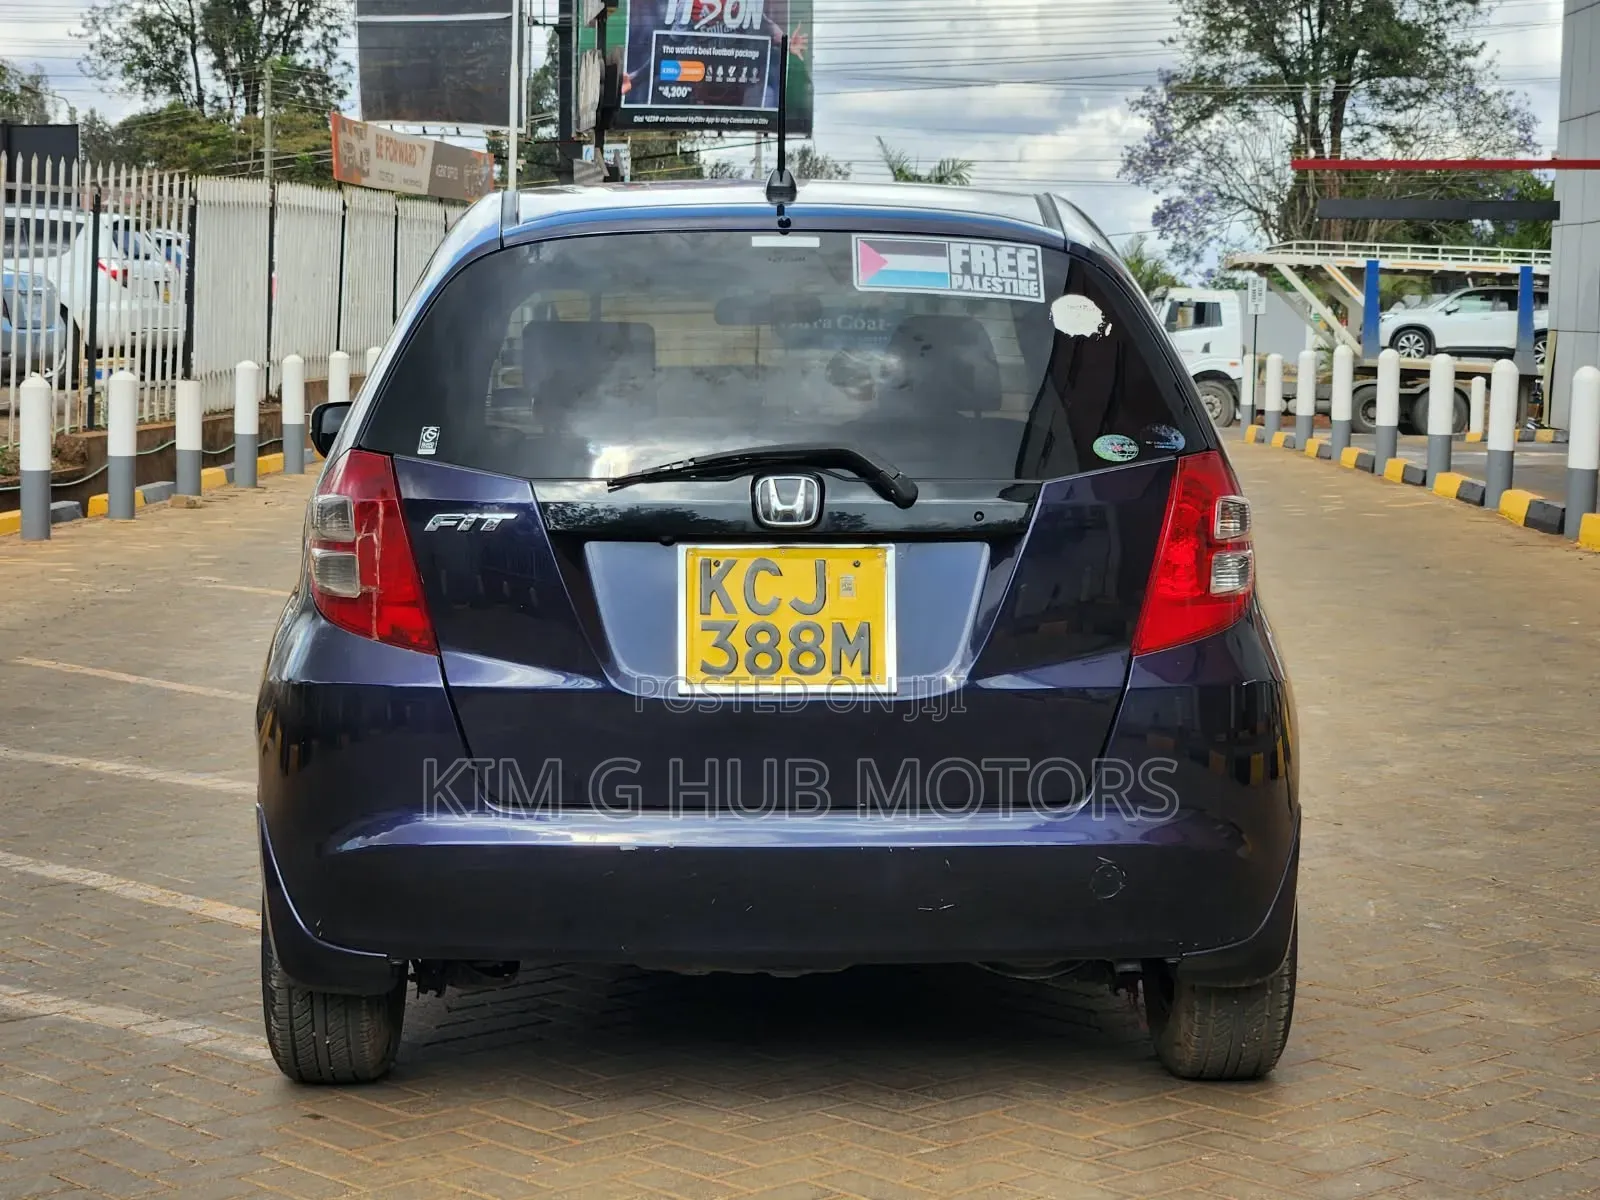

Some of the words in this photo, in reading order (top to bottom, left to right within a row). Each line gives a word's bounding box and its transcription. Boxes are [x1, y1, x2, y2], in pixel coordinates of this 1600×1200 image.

[662, 45, 674, 54] The
[675, 46, 697, 55] world's
[698, 46, 712, 55] best
[712, 47, 734, 57] football
[734, 48, 759, 60] package
[376, 133, 384, 159] BE
[385, 136, 417, 168] FORWARD
[949, 242, 1037, 280] FREE
[951, 273, 1039, 297] PALESTINE
[424, 513, 518, 532] FIT
[700, 557, 827, 616] KCJ
[700, 620, 871, 676] 388M
